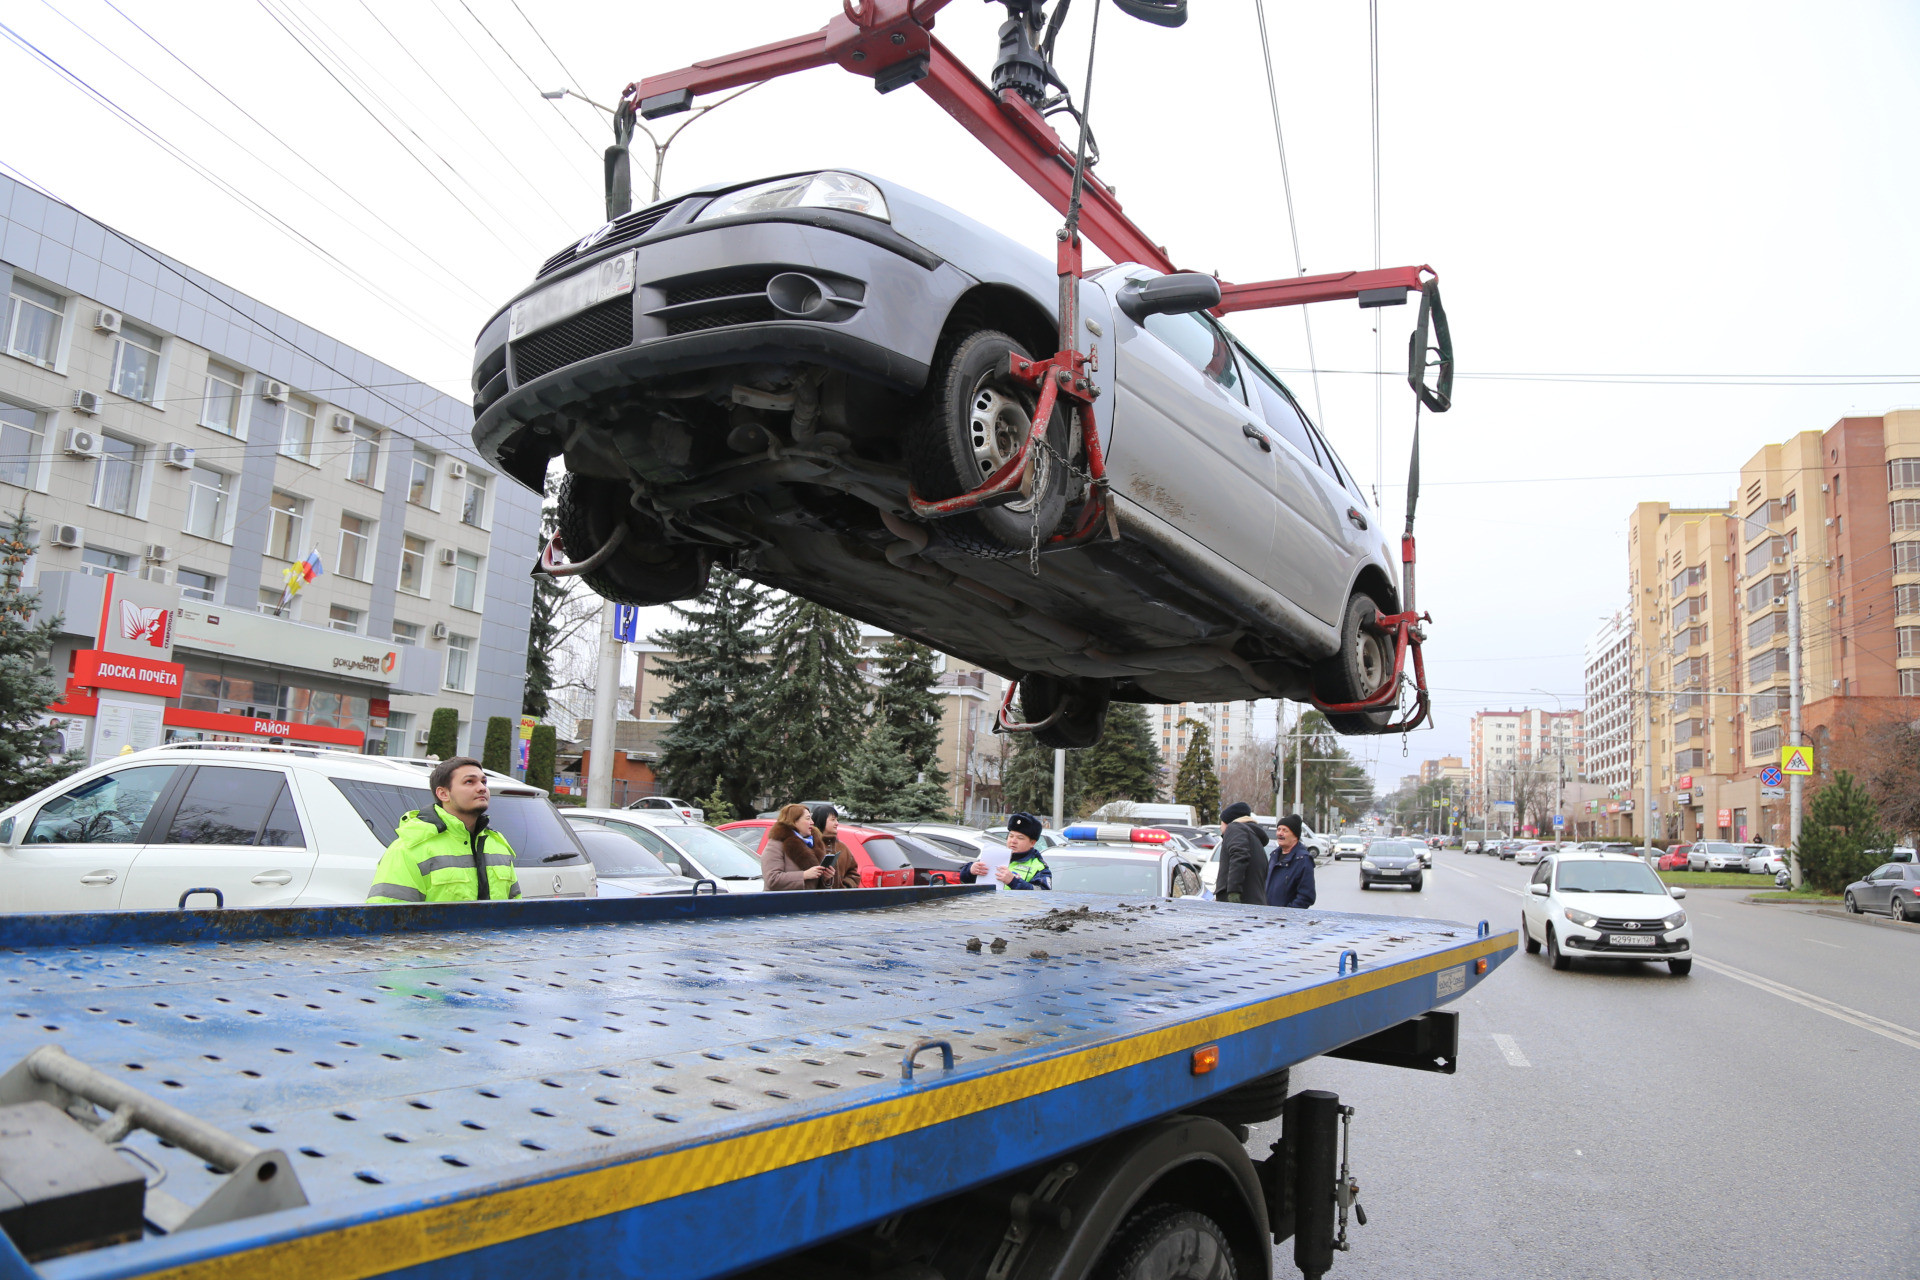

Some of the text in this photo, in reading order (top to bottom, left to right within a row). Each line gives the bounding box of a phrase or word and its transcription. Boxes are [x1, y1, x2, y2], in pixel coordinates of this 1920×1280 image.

[602, 257, 626, 287] 09
[600, 286, 617, 297] RUS
[164, 610, 174, 649] СТАВРОПОЛЬ
[97, 662, 178, 686] ДОСКА ПОЧЁТА
[333, 657, 379, 672] документы
[254, 720, 291, 736] РАЙОН
